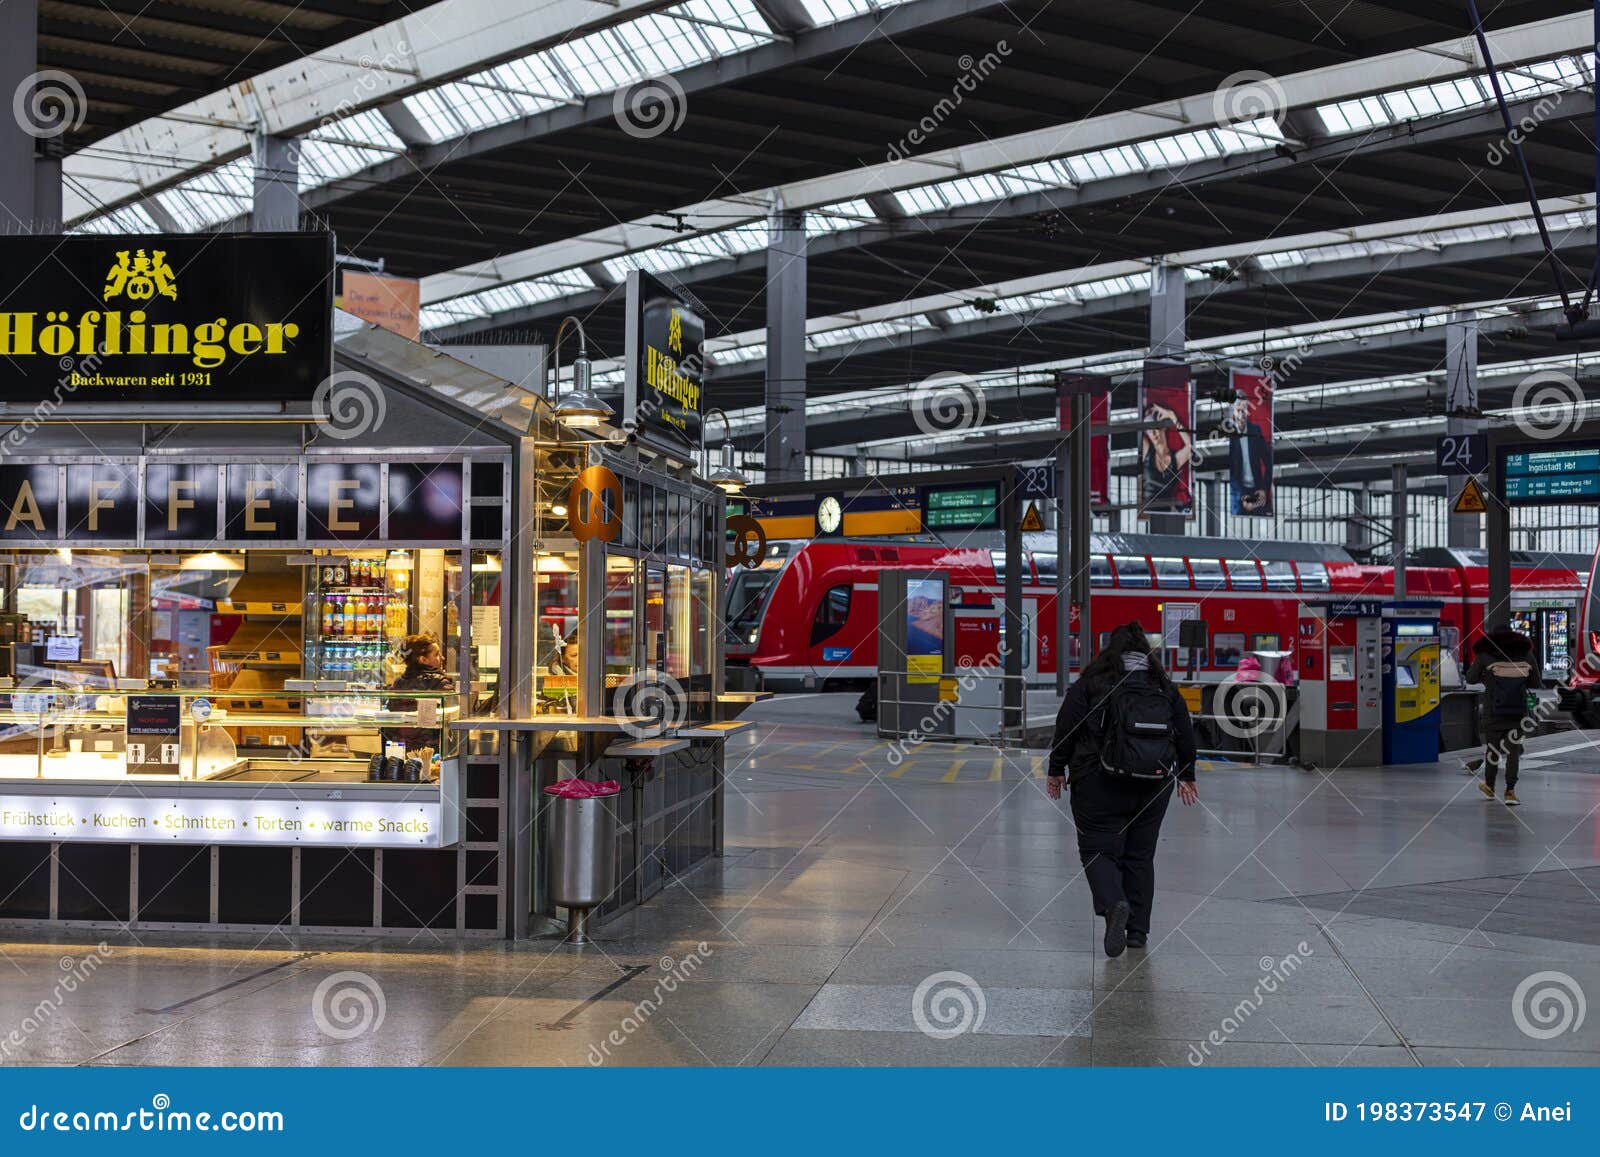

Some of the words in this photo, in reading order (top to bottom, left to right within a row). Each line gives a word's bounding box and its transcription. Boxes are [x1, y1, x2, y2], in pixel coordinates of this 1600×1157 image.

[0, 310, 299, 368] Höflinger
[71, 373, 147, 387] Backwaren
[151, 373, 175, 386] seit
[179, 373, 212, 386] 1931
[1441, 436, 1472, 466] 24
[1026, 467, 1048, 492] 23
[3, 810, 75, 828] Frühstück
[93, 812, 146, 828] Kuchen
[165, 814, 236, 830] Schnitten
[254, 816, 302, 832] Torten
[322, 819, 373, 833] warme
[378, 817, 429, 834] Snacks
